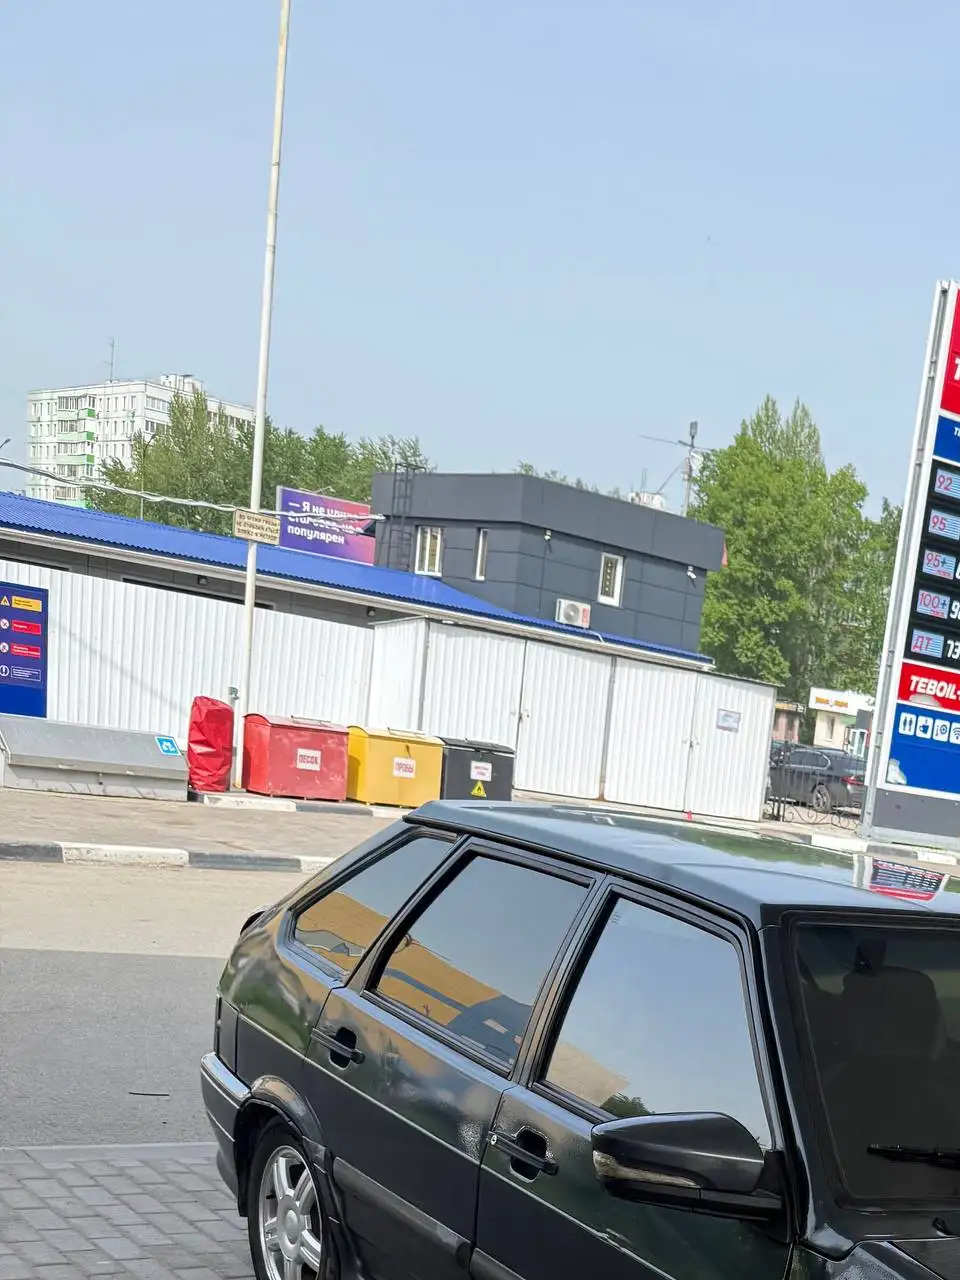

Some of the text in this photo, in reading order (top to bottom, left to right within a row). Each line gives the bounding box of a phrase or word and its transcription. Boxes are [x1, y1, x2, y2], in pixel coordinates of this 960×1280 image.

[937, 474, 953, 492] 92
[302, 501, 310, 512] Я
[931, 514, 947, 532] 95
[287, 525, 345, 545] популярен
[925, 552, 947, 568] 95+
[918, 591, 947, 610] 100+
[912, 636, 933, 652] ДТ
[299, 754, 318, 765] ПЕСОК
